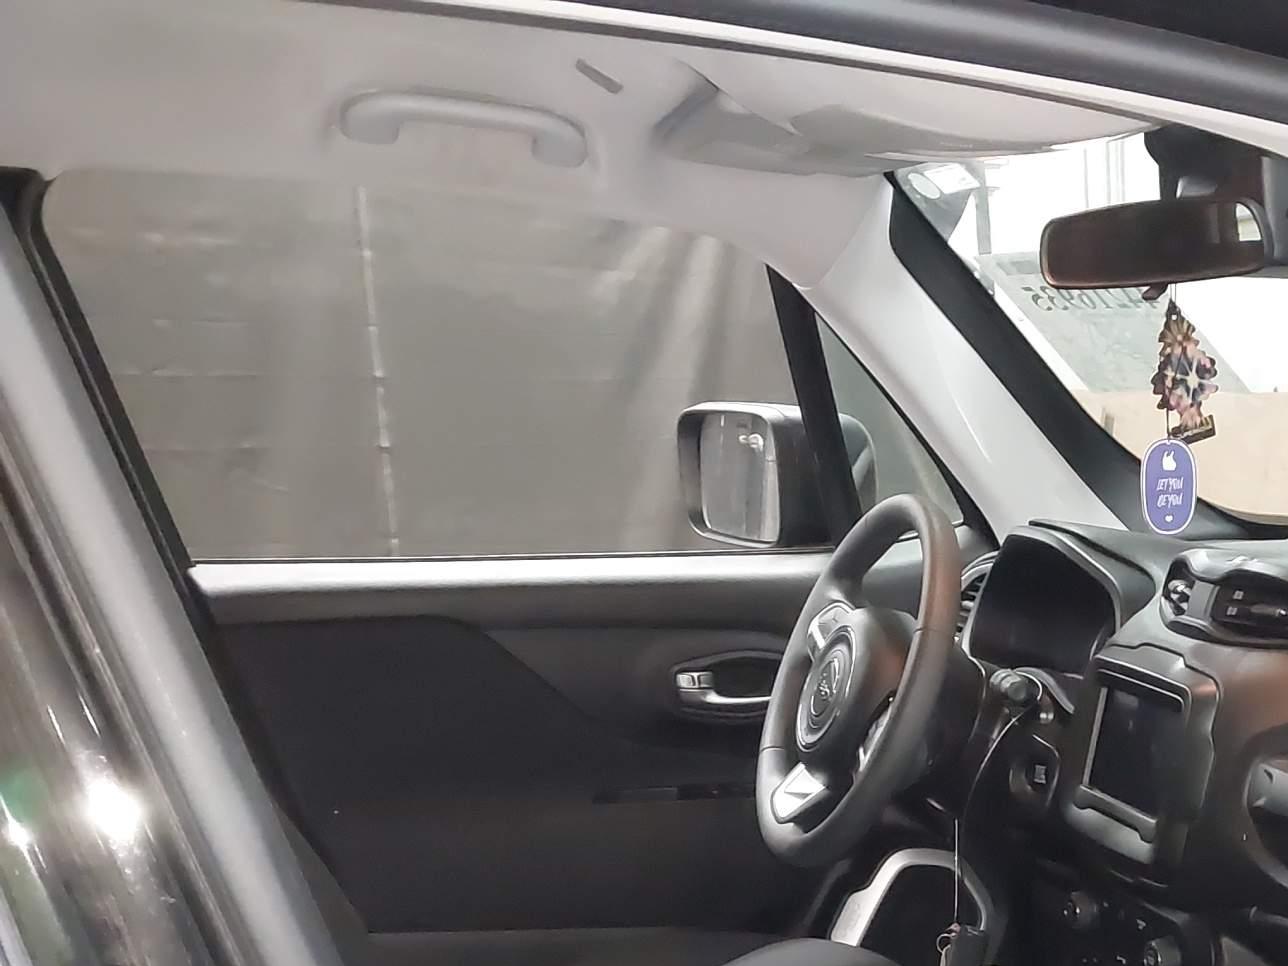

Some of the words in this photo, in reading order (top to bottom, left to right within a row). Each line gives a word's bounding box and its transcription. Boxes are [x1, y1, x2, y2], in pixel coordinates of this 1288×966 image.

[1156, 478, 1169, 491] LET
[1168, 476, 1184, 492] YOU
[1156, 493, 1168, 508] BE
[1167, 492, 1183, 509] YOU
